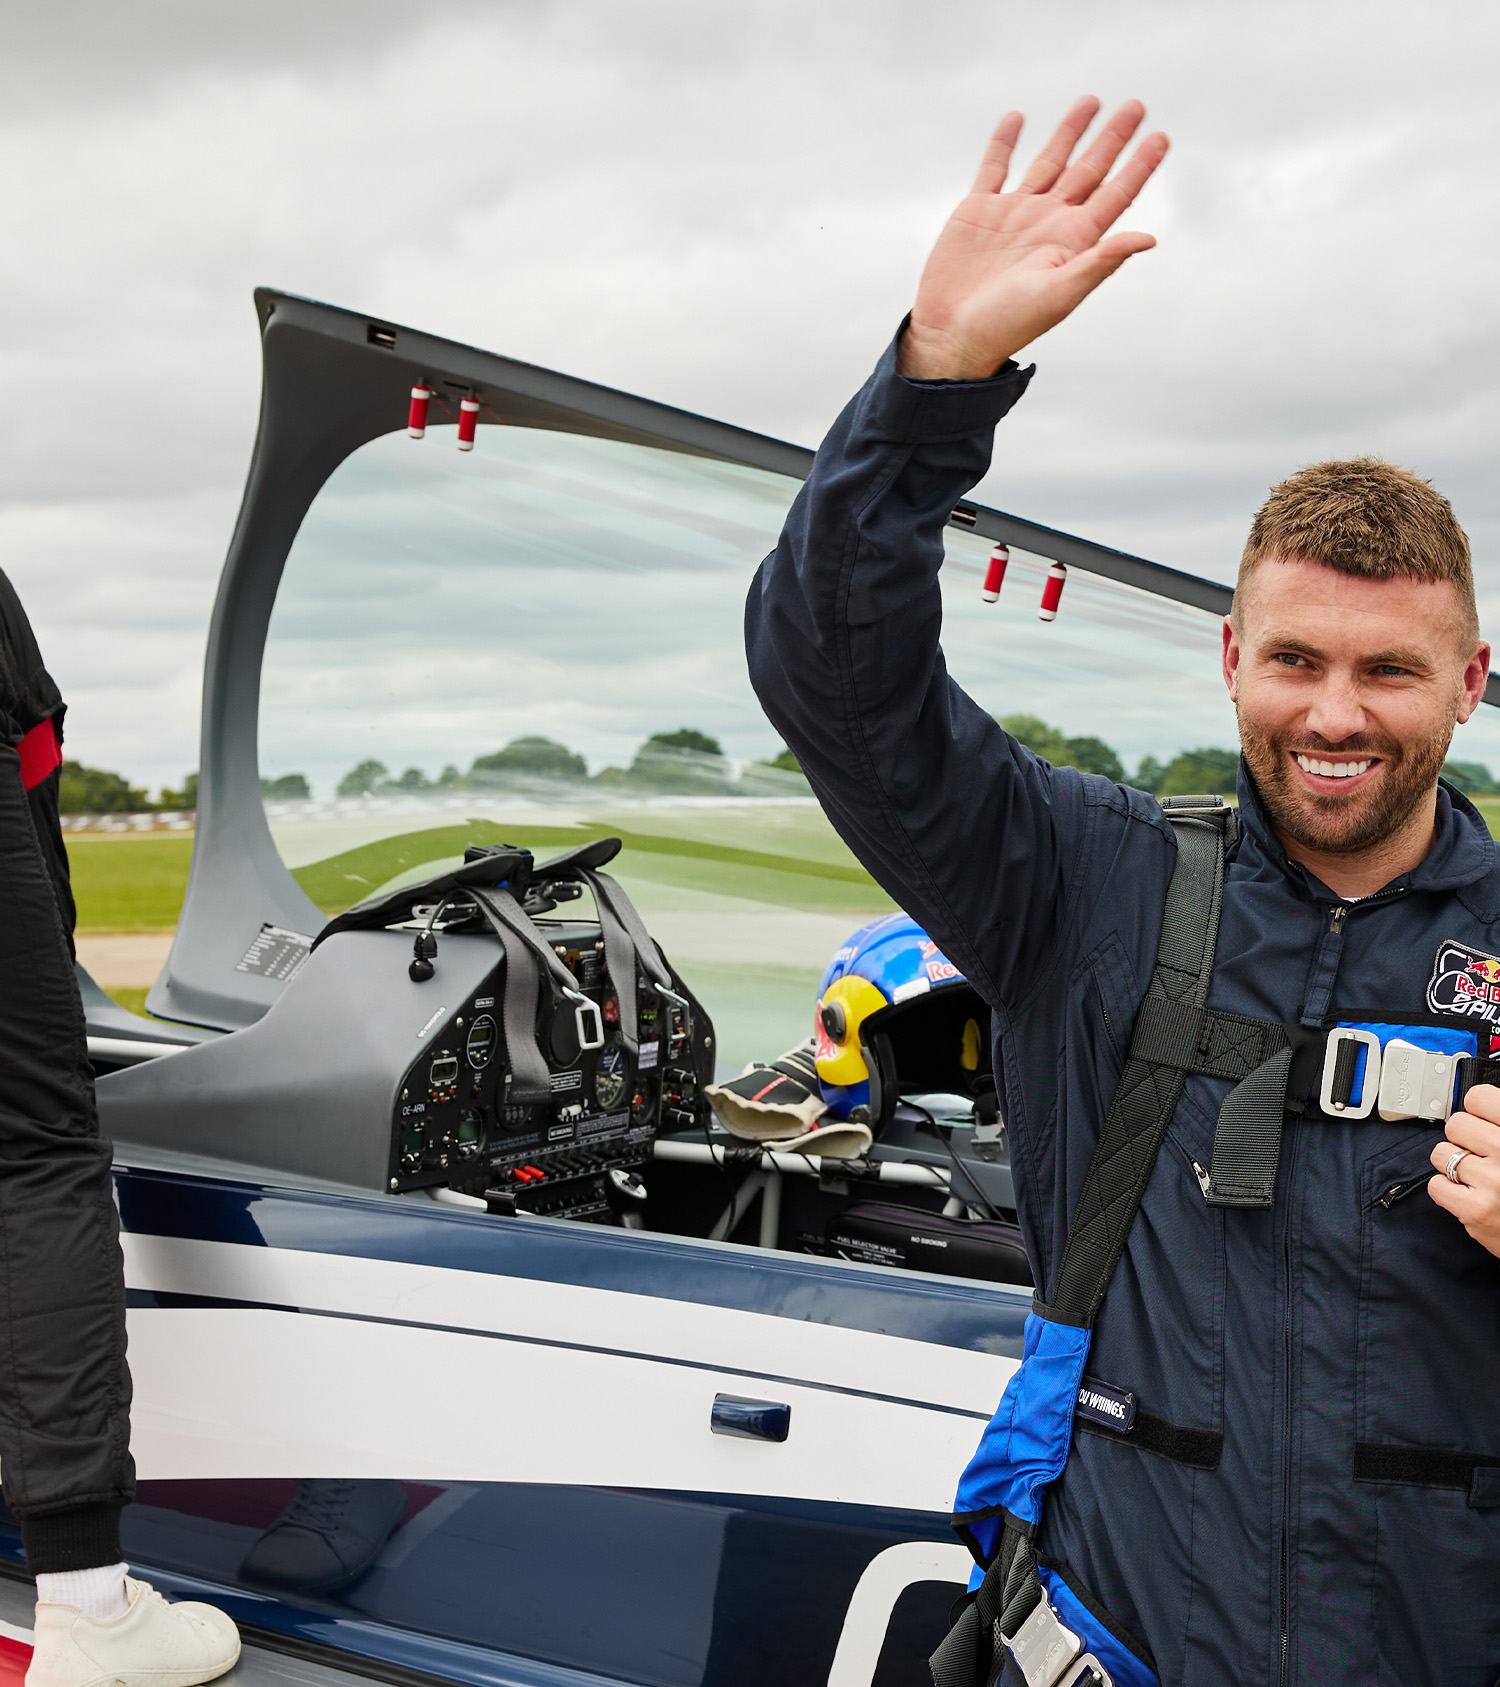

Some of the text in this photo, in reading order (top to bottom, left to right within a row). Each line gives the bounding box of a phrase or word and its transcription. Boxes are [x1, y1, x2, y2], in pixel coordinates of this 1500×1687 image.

[926, 960, 962, 982] Re
[1455, 974, 1489, 1001] Red
[837, 1236, 851, 1245] FUEL
[852, 1239, 879, 1250] SELECTOR
[880, 1244, 897, 1254] VALVE
[910, 1236, 948, 1248] NO SMOKING
[1079, 1388, 1091, 1404] OU
